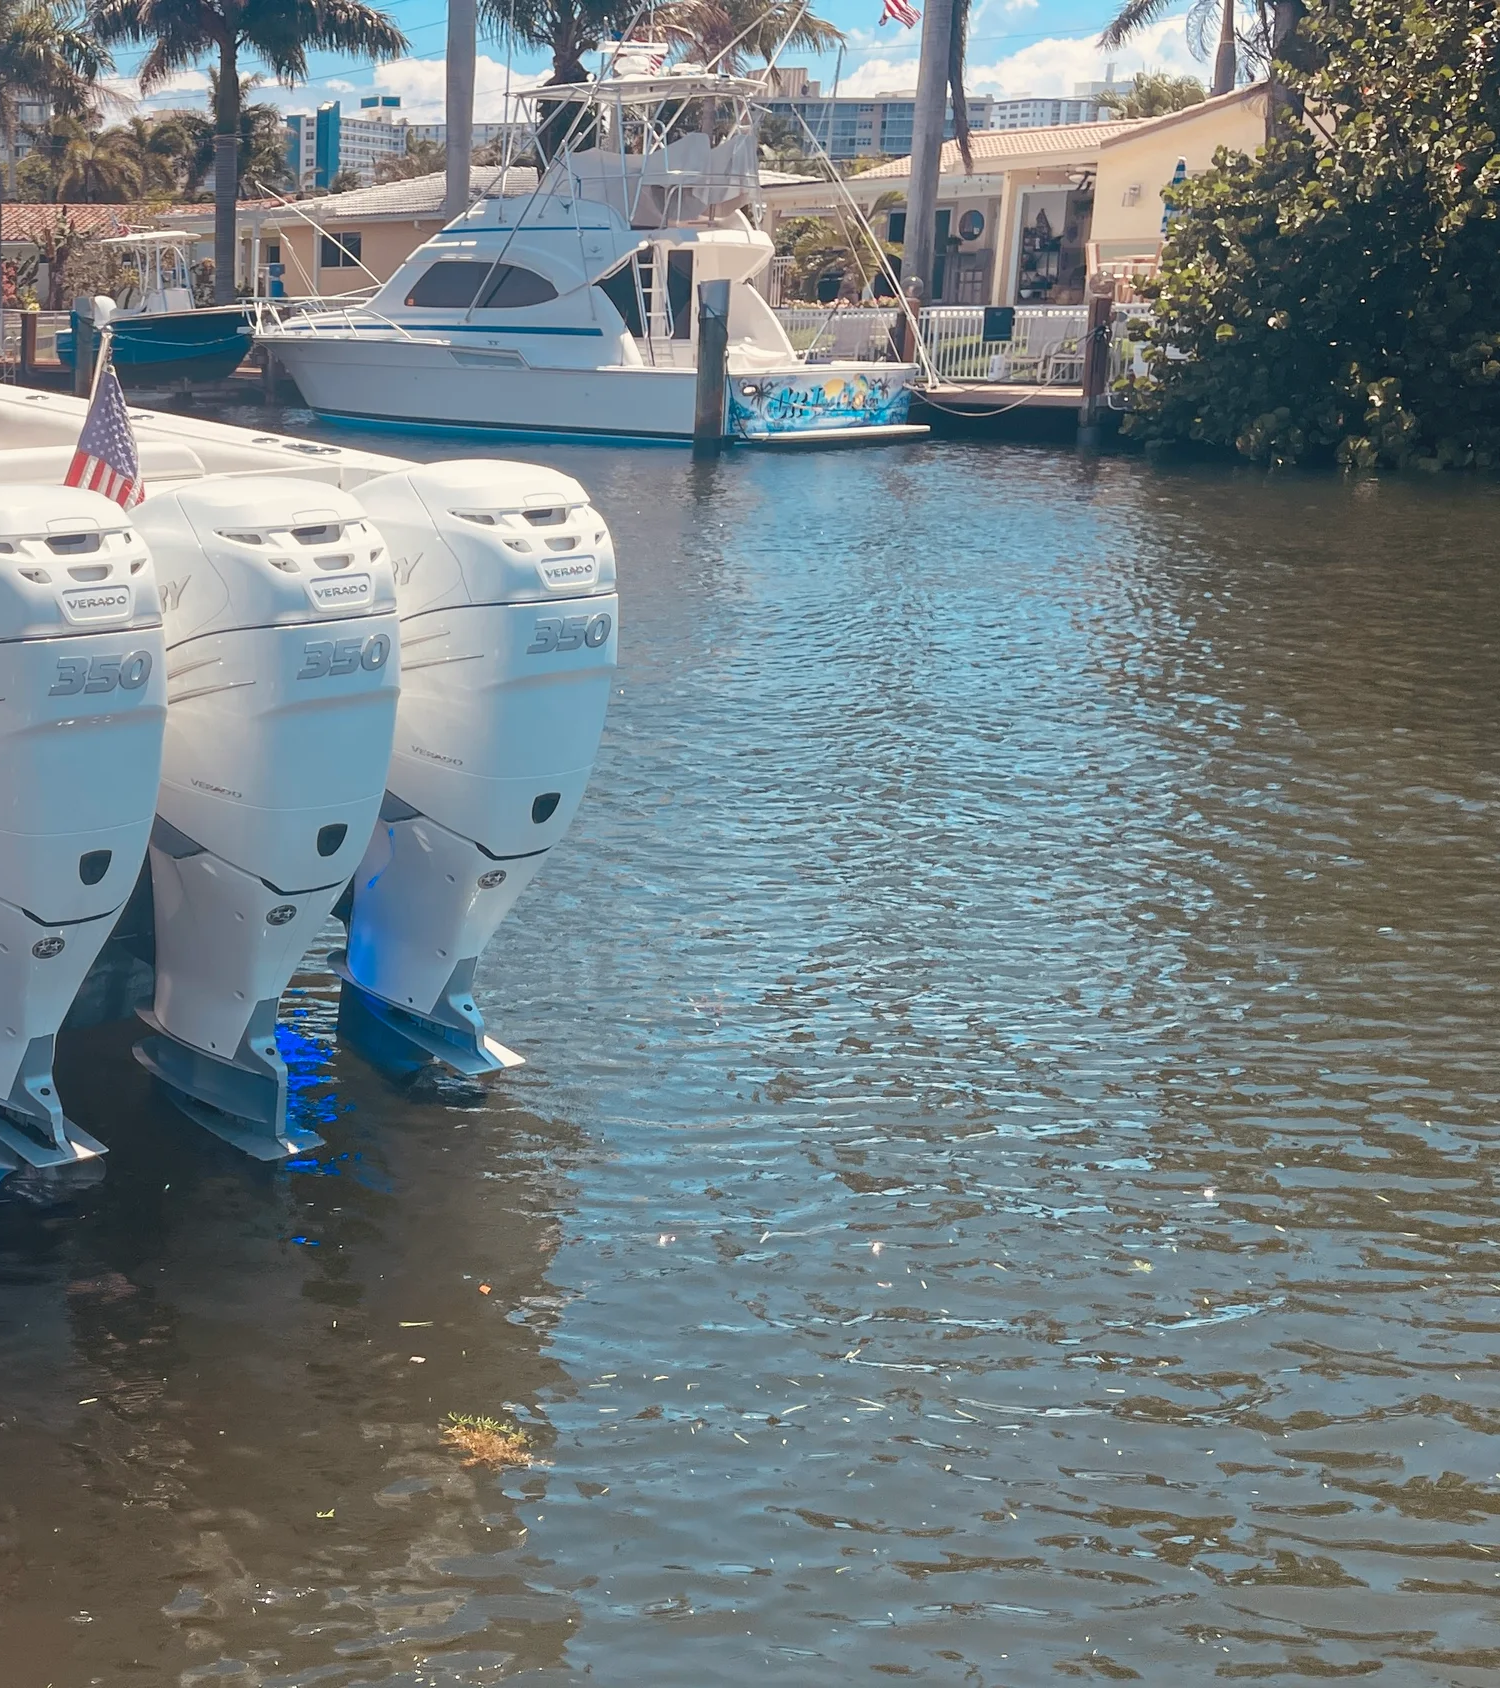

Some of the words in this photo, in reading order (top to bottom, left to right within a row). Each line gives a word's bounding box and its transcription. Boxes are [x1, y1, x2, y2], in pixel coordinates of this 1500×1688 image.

[544, 564, 593, 579] VERADO
[66, 595, 127, 610] VERADO
[313, 583, 368, 598] VERADO
[526, 612, 612, 655] 350
[296, 633, 391, 680] 350
[48, 649, 153, 697] 350
